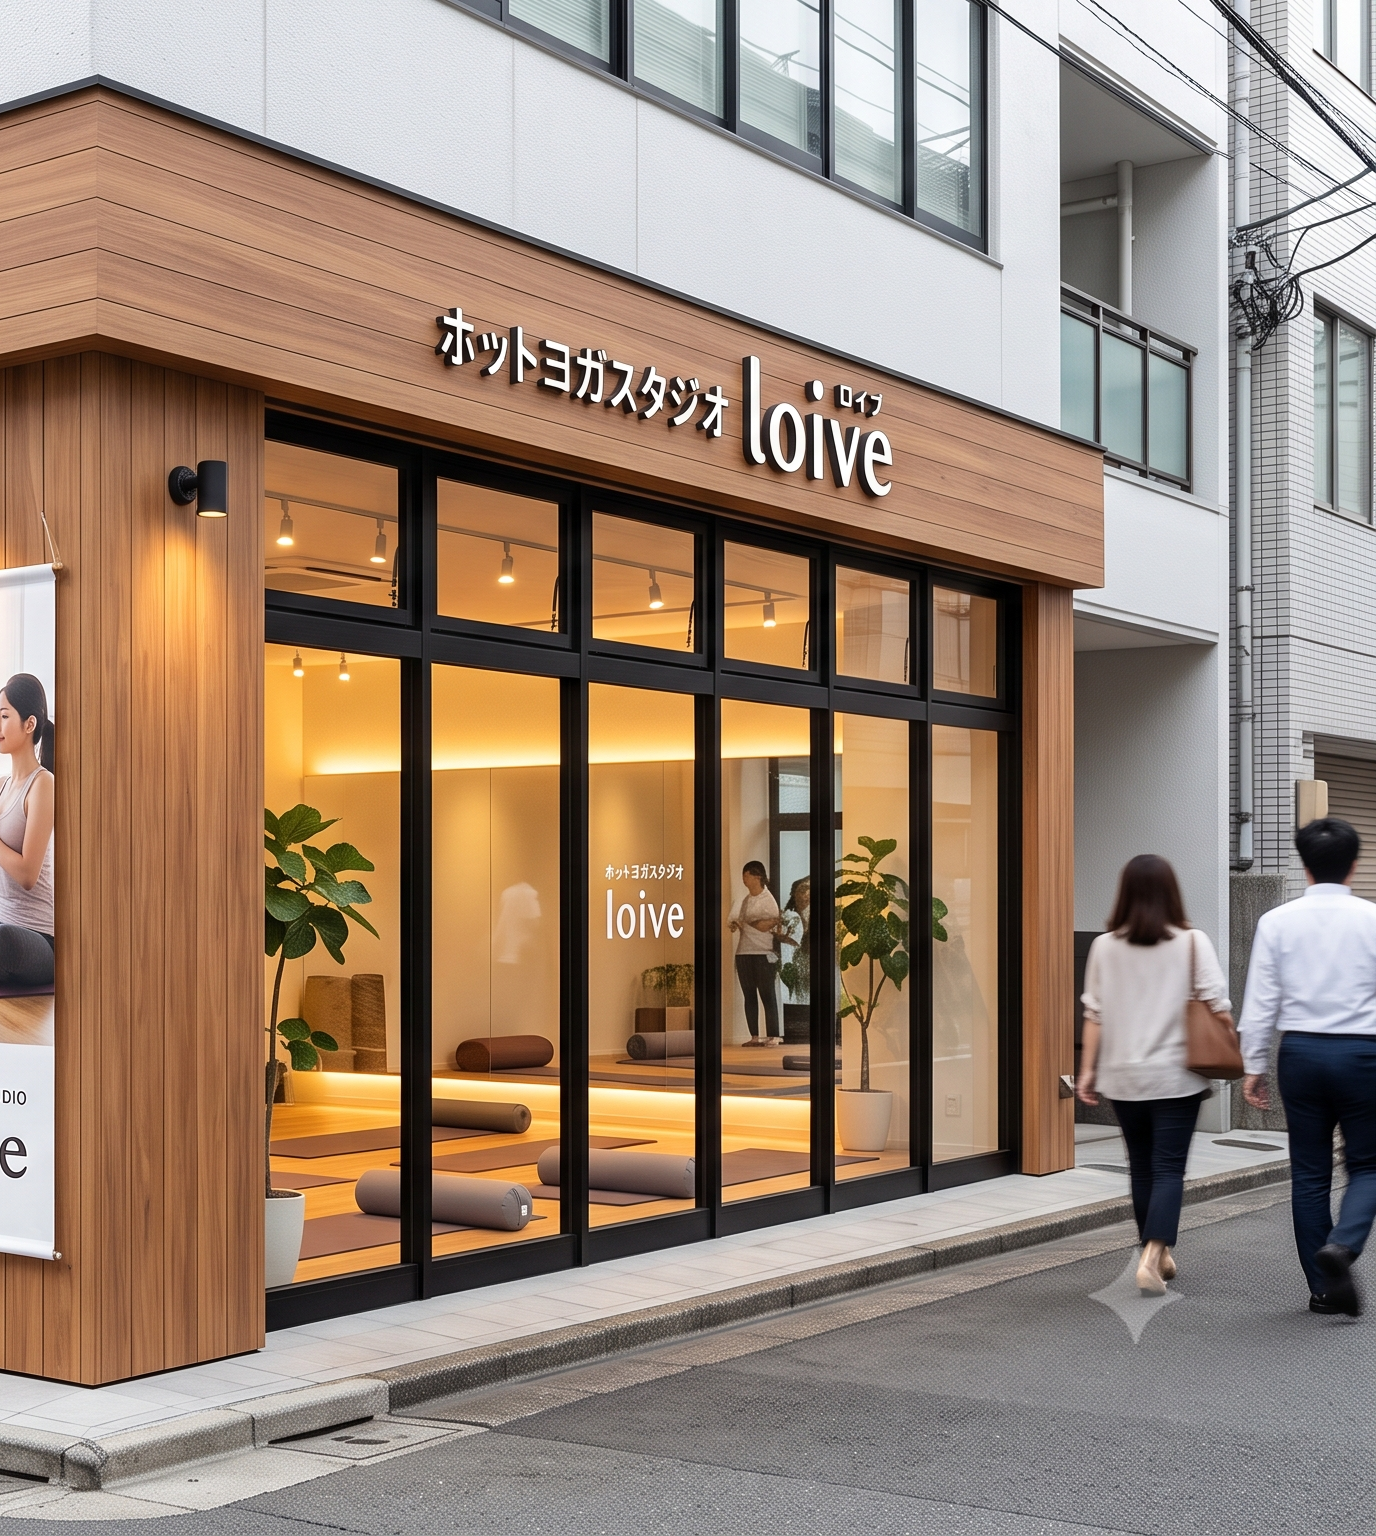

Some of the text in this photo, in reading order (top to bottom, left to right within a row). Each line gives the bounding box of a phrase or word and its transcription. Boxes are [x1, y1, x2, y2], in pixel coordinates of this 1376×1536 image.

[435, 307, 729, 439] ホットヨガスタジオ
[742, 355, 893, 497] loive
[605, 863, 684, 880] ホットヨガスタジオ
[606, 888, 684, 940] loive
